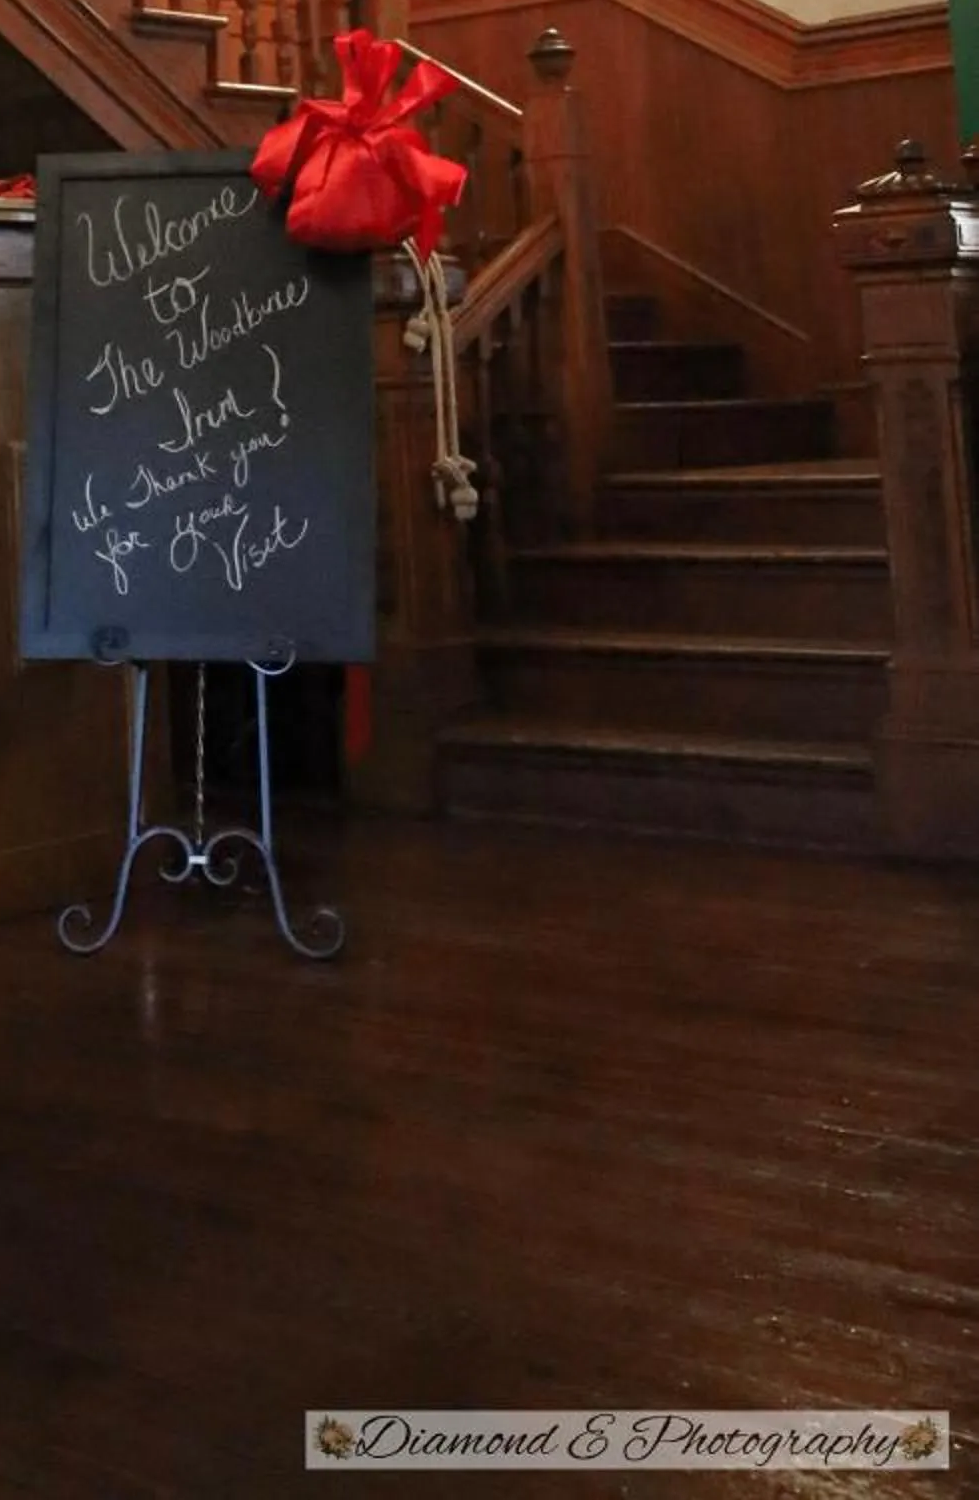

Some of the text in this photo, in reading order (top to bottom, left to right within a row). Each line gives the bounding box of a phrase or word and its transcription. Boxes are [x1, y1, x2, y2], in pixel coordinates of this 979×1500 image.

[77, 187, 259, 288] Welcome
[143, 266, 211, 324] to
[86, 344, 164, 414] The
[72, 474, 113, 530] We
[230, 431, 287, 488] you
[94, 531, 151, 595] for
